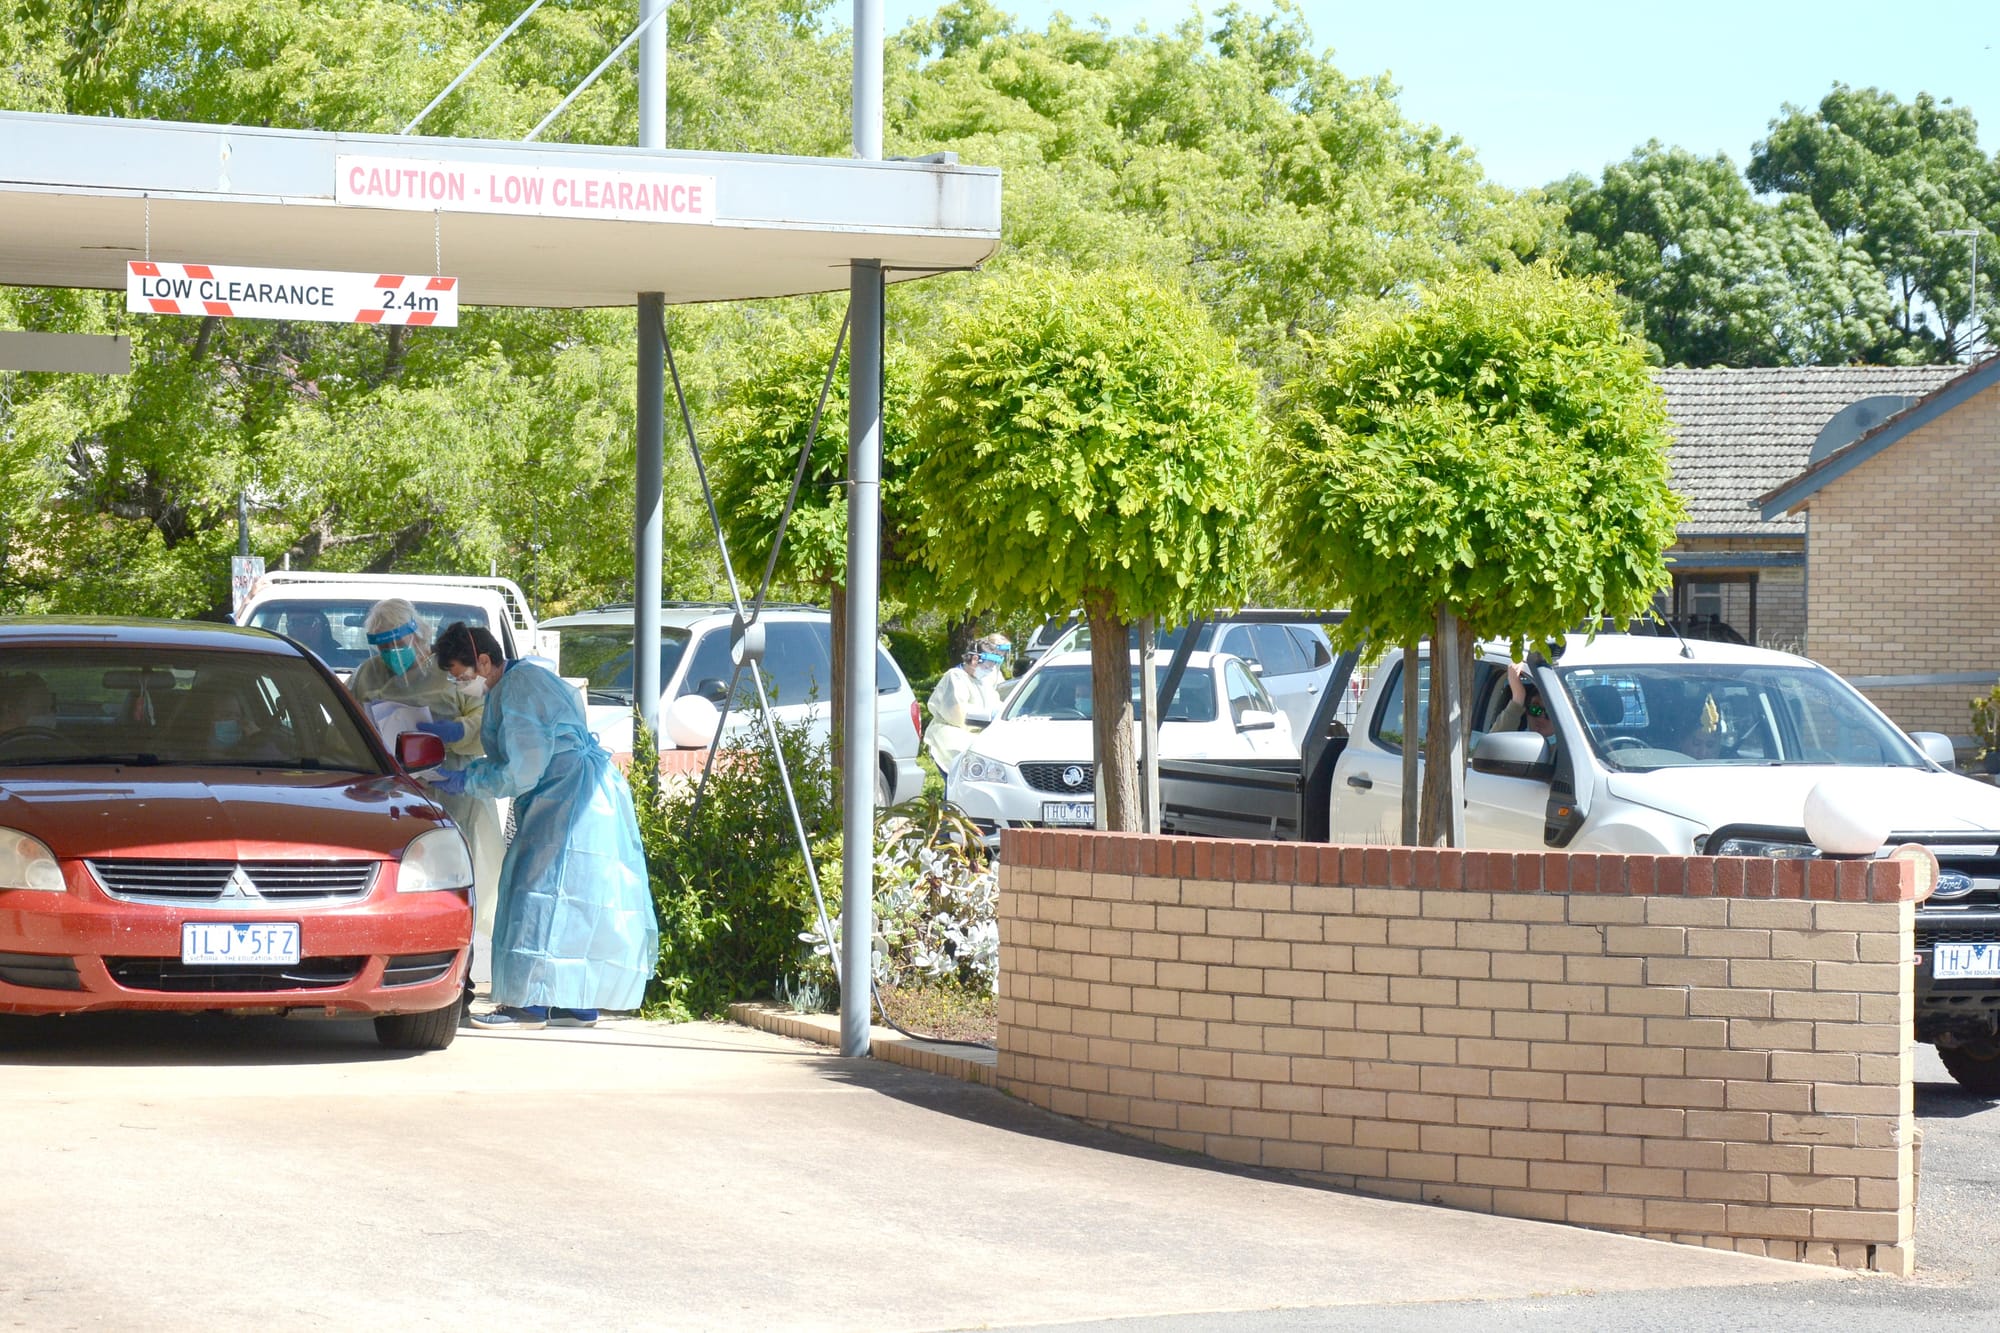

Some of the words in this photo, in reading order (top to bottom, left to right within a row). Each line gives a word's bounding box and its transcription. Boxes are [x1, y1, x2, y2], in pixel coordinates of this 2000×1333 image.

[349, 166, 465, 201] CAUTION
[490, 174, 544, 206] LOW
[552, 178, 702, 214] CLEARANCE
[142, 277, 193, 299] LOW
[200, 280, 334, 306] CLEARANCE
[382, 290, 439, 311] 2.4m
[1941, 949, 1971, 970] 1HJ
